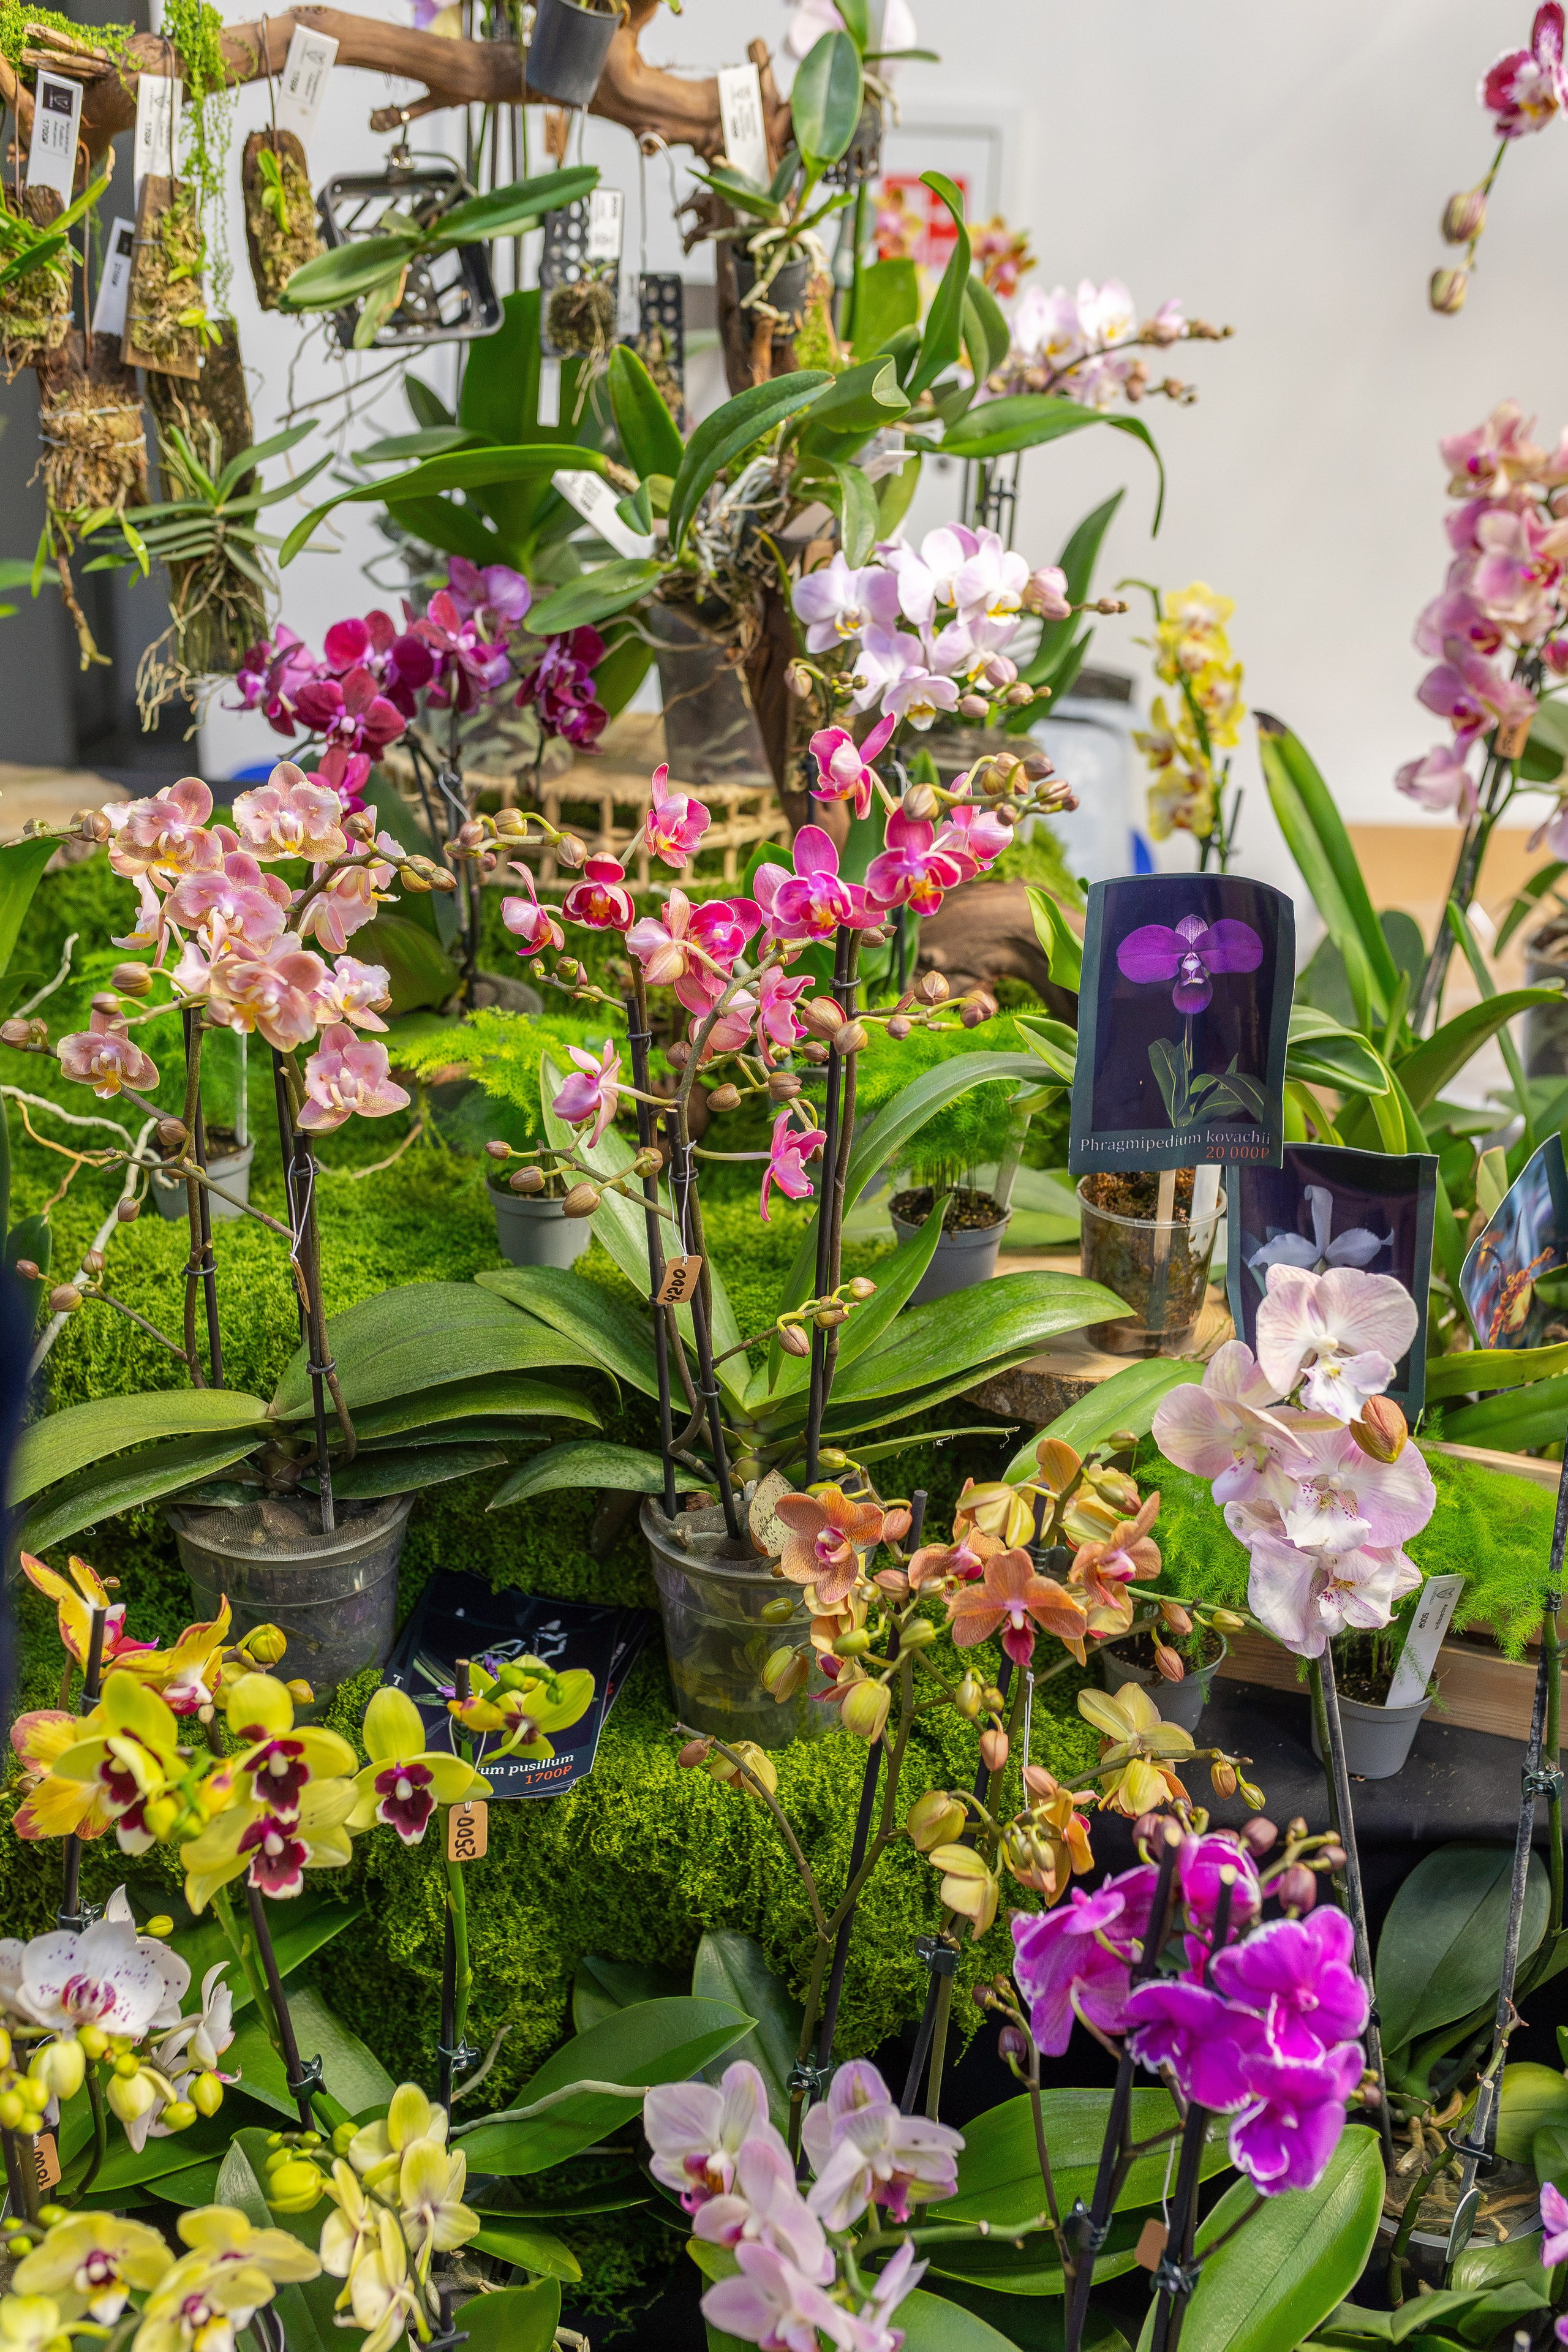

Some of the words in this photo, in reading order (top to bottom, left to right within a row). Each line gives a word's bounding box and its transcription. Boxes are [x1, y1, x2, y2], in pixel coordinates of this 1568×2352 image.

[1080, 1134, 1201, 1153] Phragmipedium
[1207, 1129, 1270, 1144] kovachii
[1206, 1146, 1224, 1159] 20
[663, 1268, 687, 1302] 4200
[508, 1754, 574, 1776] pusillum
[454, 1817, 476, 1858] 2500
